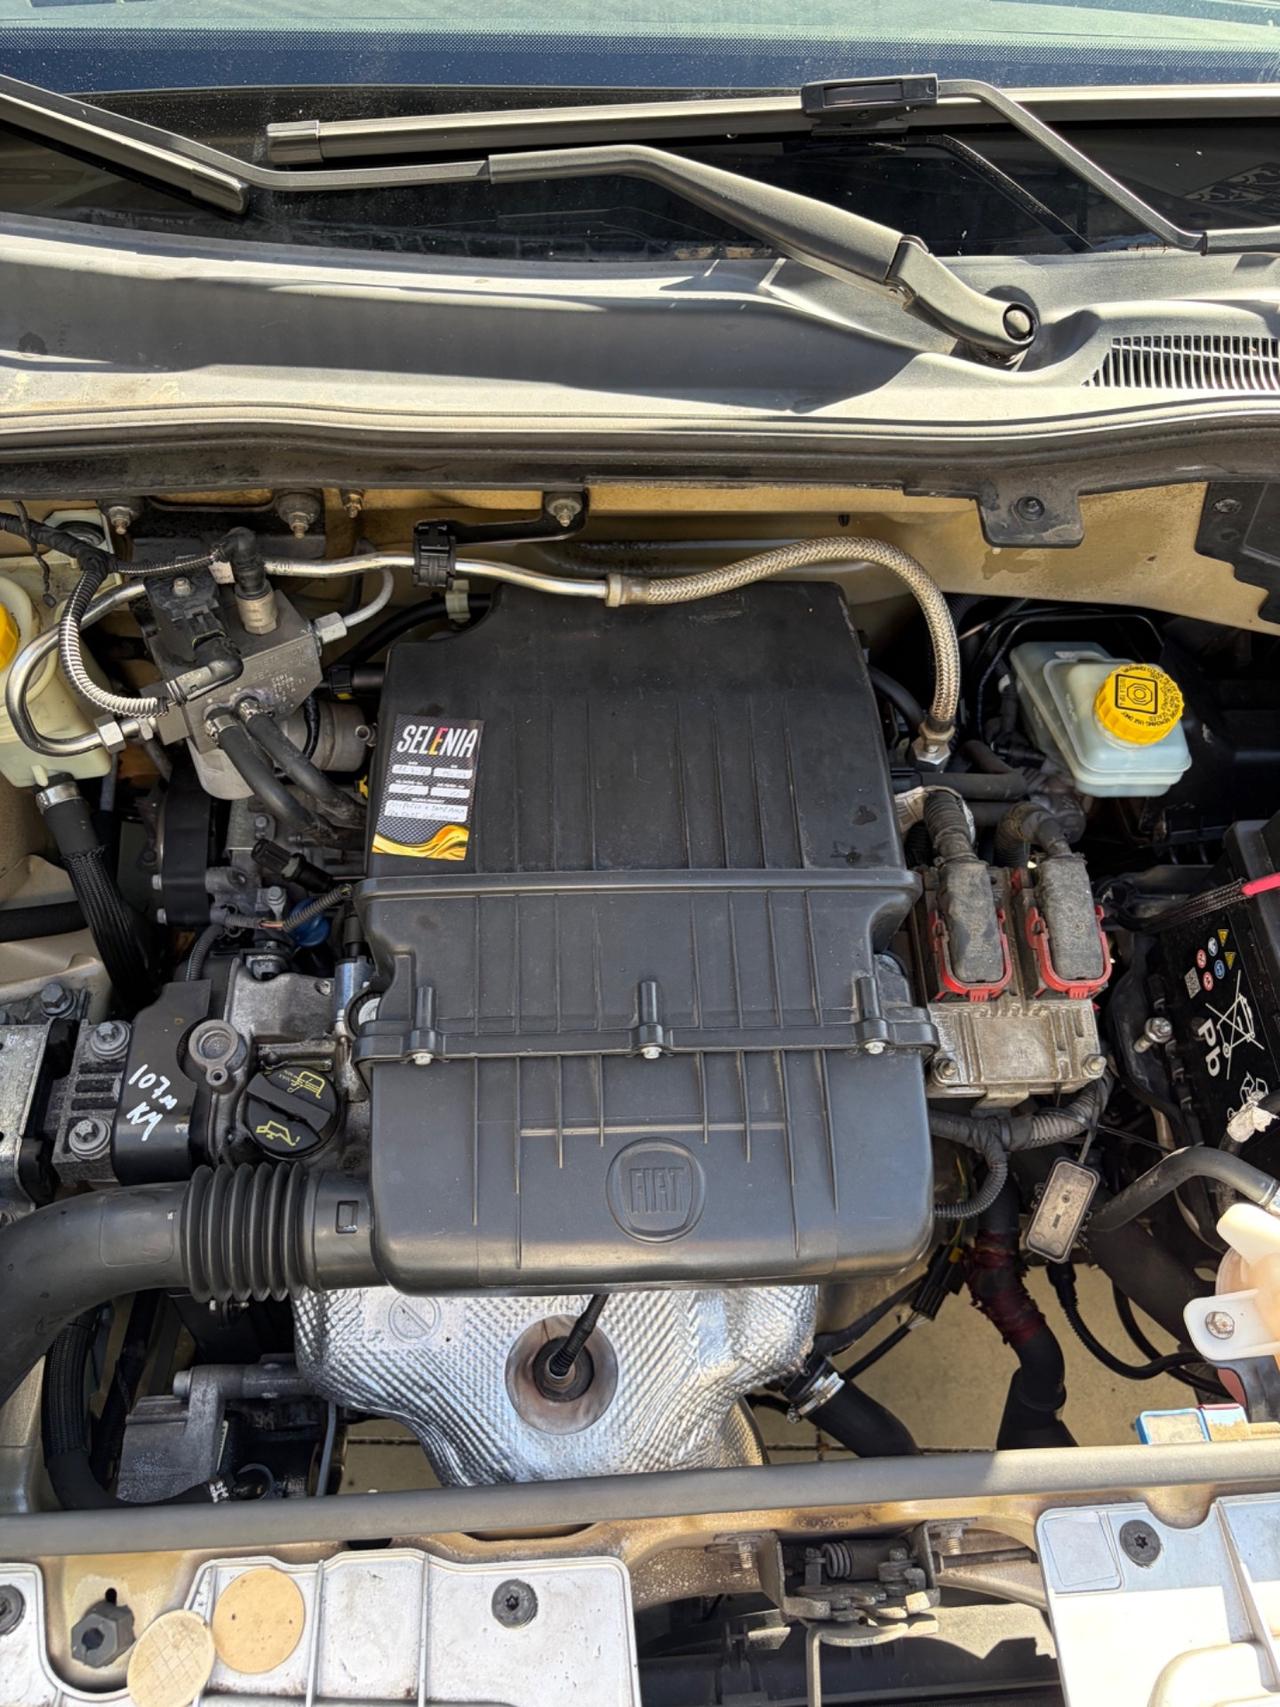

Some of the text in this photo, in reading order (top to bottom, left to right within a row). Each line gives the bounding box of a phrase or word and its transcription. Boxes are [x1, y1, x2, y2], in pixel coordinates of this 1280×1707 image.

[396, 725, 478, 757] SELENIA
[1198, 1018, 1220, 1077] Pb
[629, 1167, 685, 1213] FIAT
